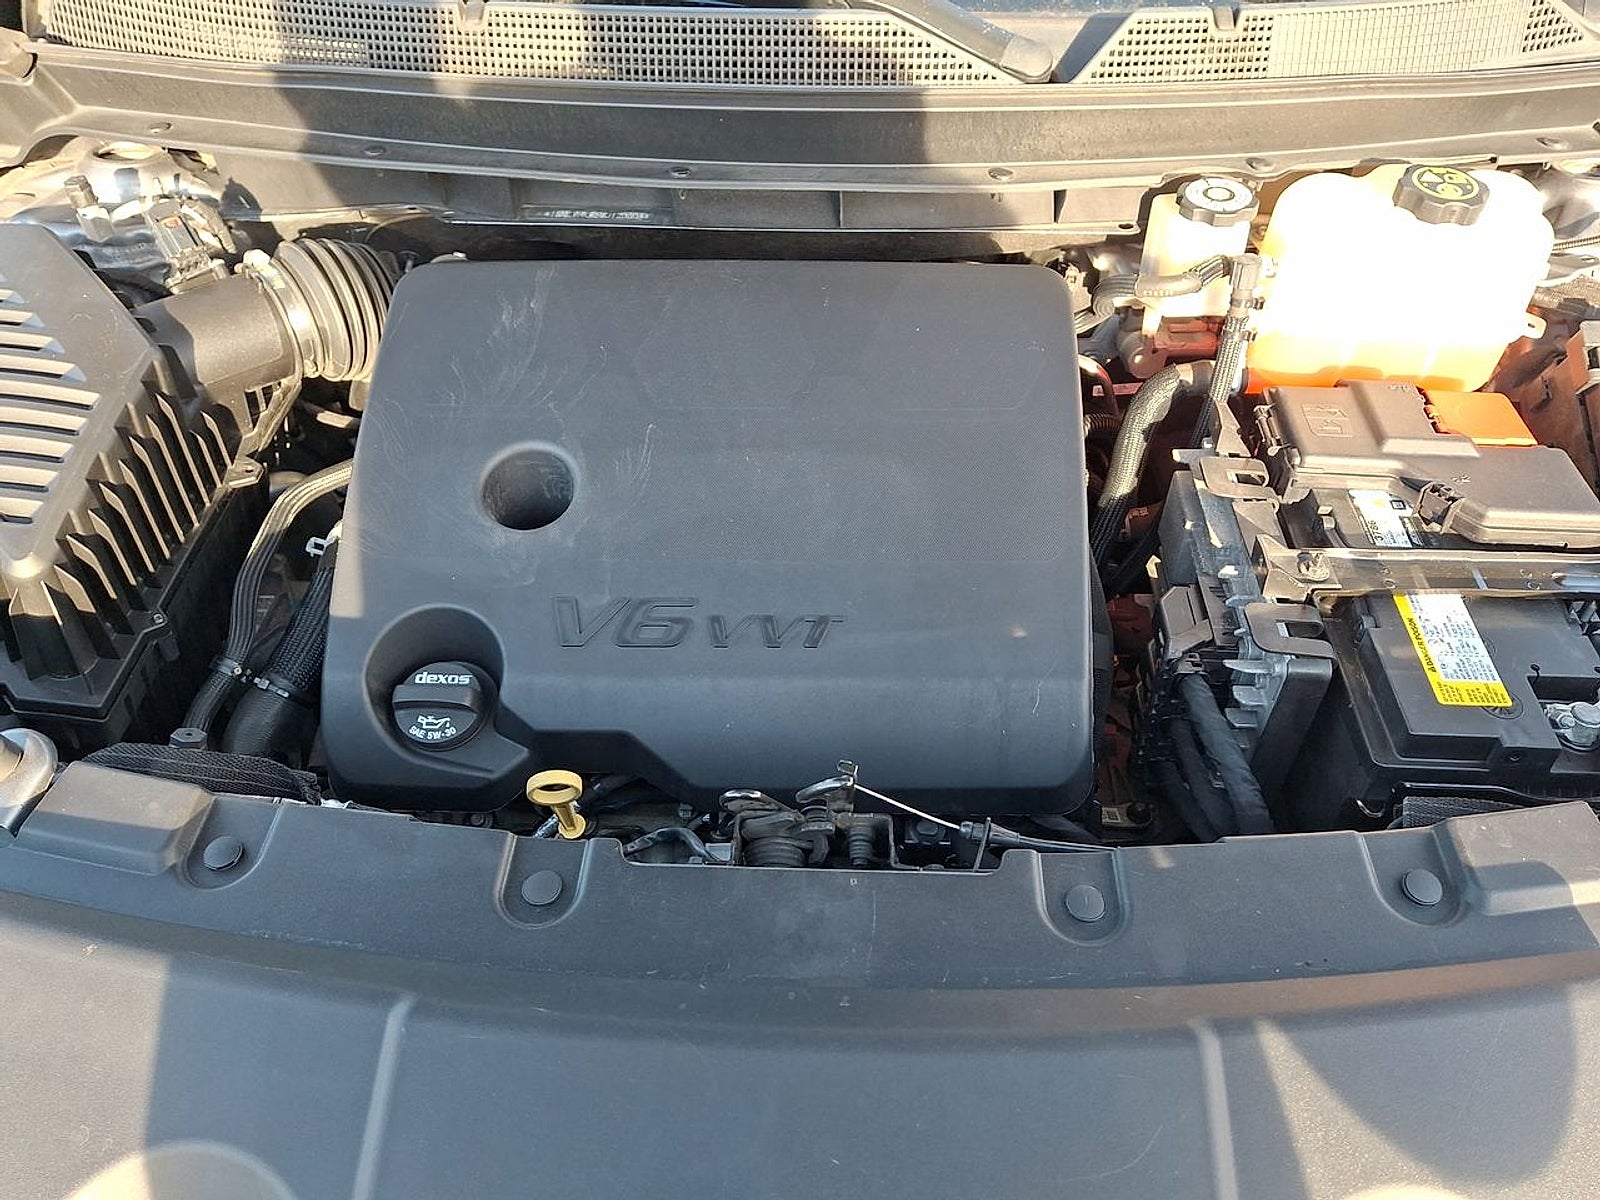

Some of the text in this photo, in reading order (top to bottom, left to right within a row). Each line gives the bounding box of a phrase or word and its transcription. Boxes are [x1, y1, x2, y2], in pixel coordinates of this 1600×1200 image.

[552, 596, 845, 648] V6 VVT
[414, 671, 473, 684] dexos
[408, 725, 457, 740] SAE 5W-30
